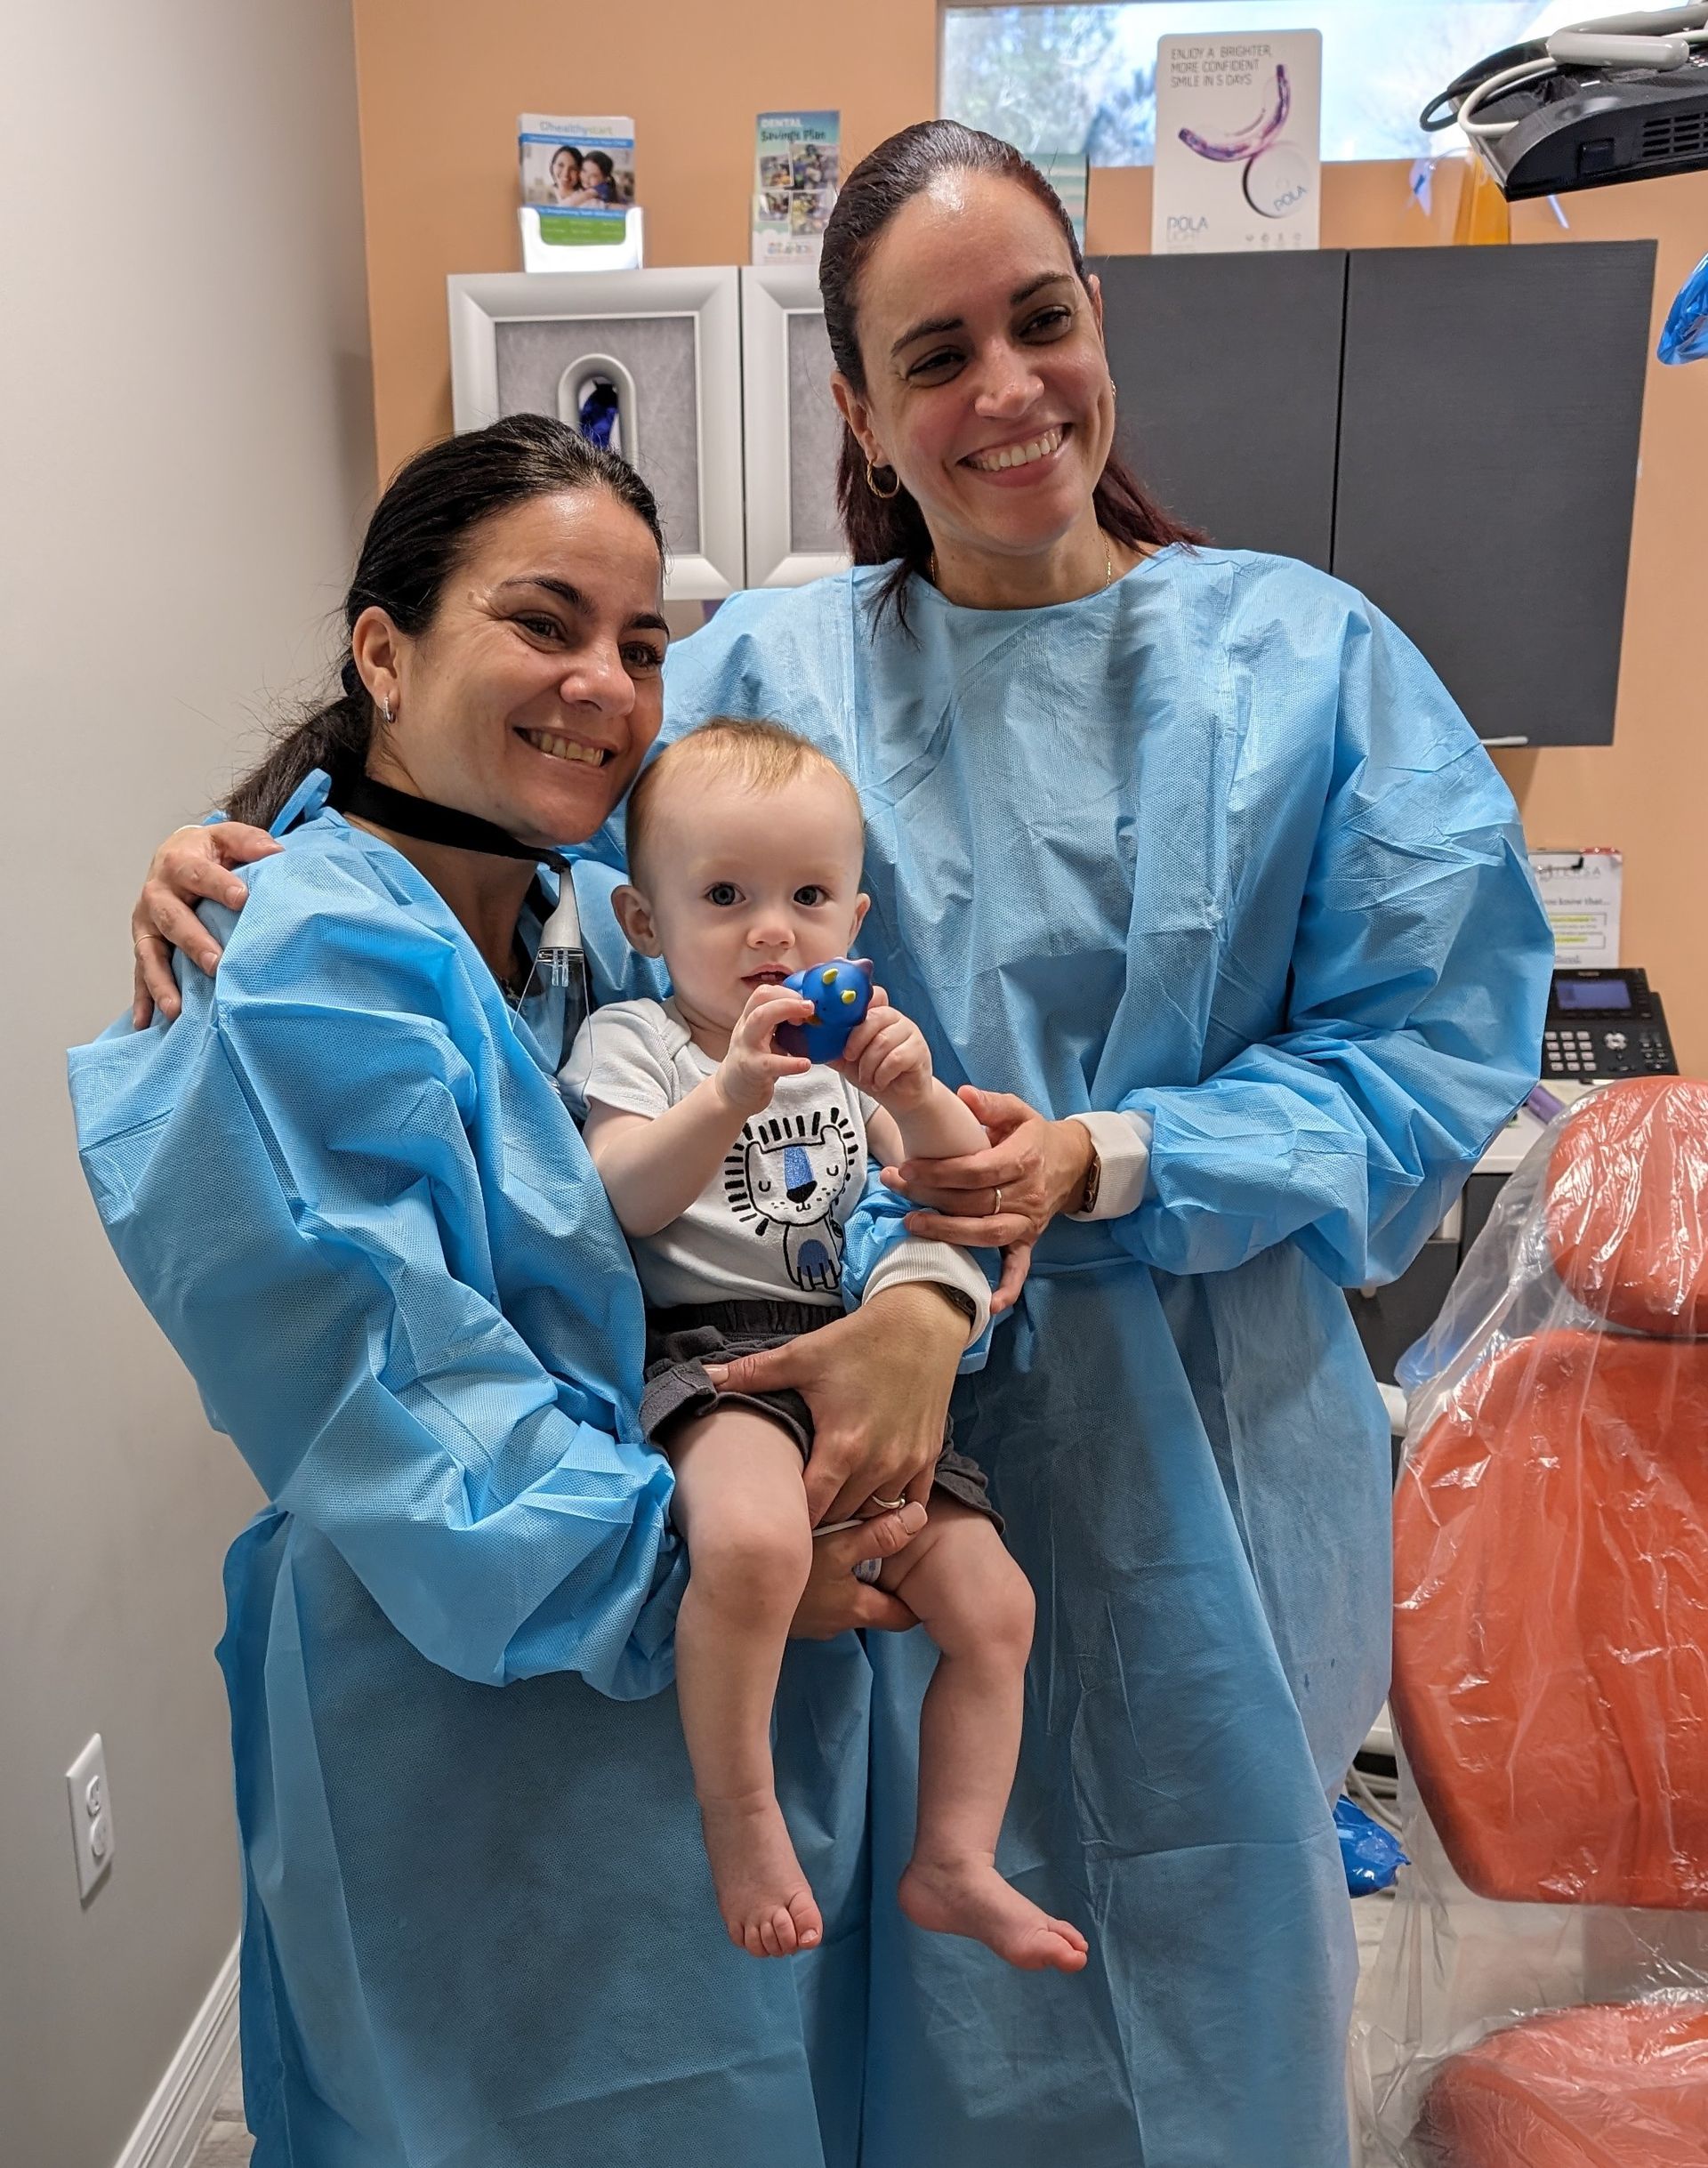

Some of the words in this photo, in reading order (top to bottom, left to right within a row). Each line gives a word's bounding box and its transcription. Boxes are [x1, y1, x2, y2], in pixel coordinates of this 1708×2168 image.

[1171, 48, 1204, 60] ENJOY
[1206, 47, 1215, 58] A
[1171, 62, 1197, 73] MORE
[1202, 59, 1260, 72] CONFIDENT
[1171, 76, 1199, 87] SMILE
[1203, 75, 1214, 86] IN
[1225, 73, 1253, 85] DAYS
[761, 131, 801, 143] Savings
[803, 129, 826, 141] Plan
[1273, 185, 1308, 212] POLA
[1166, 216, 1209, 231] POLA
